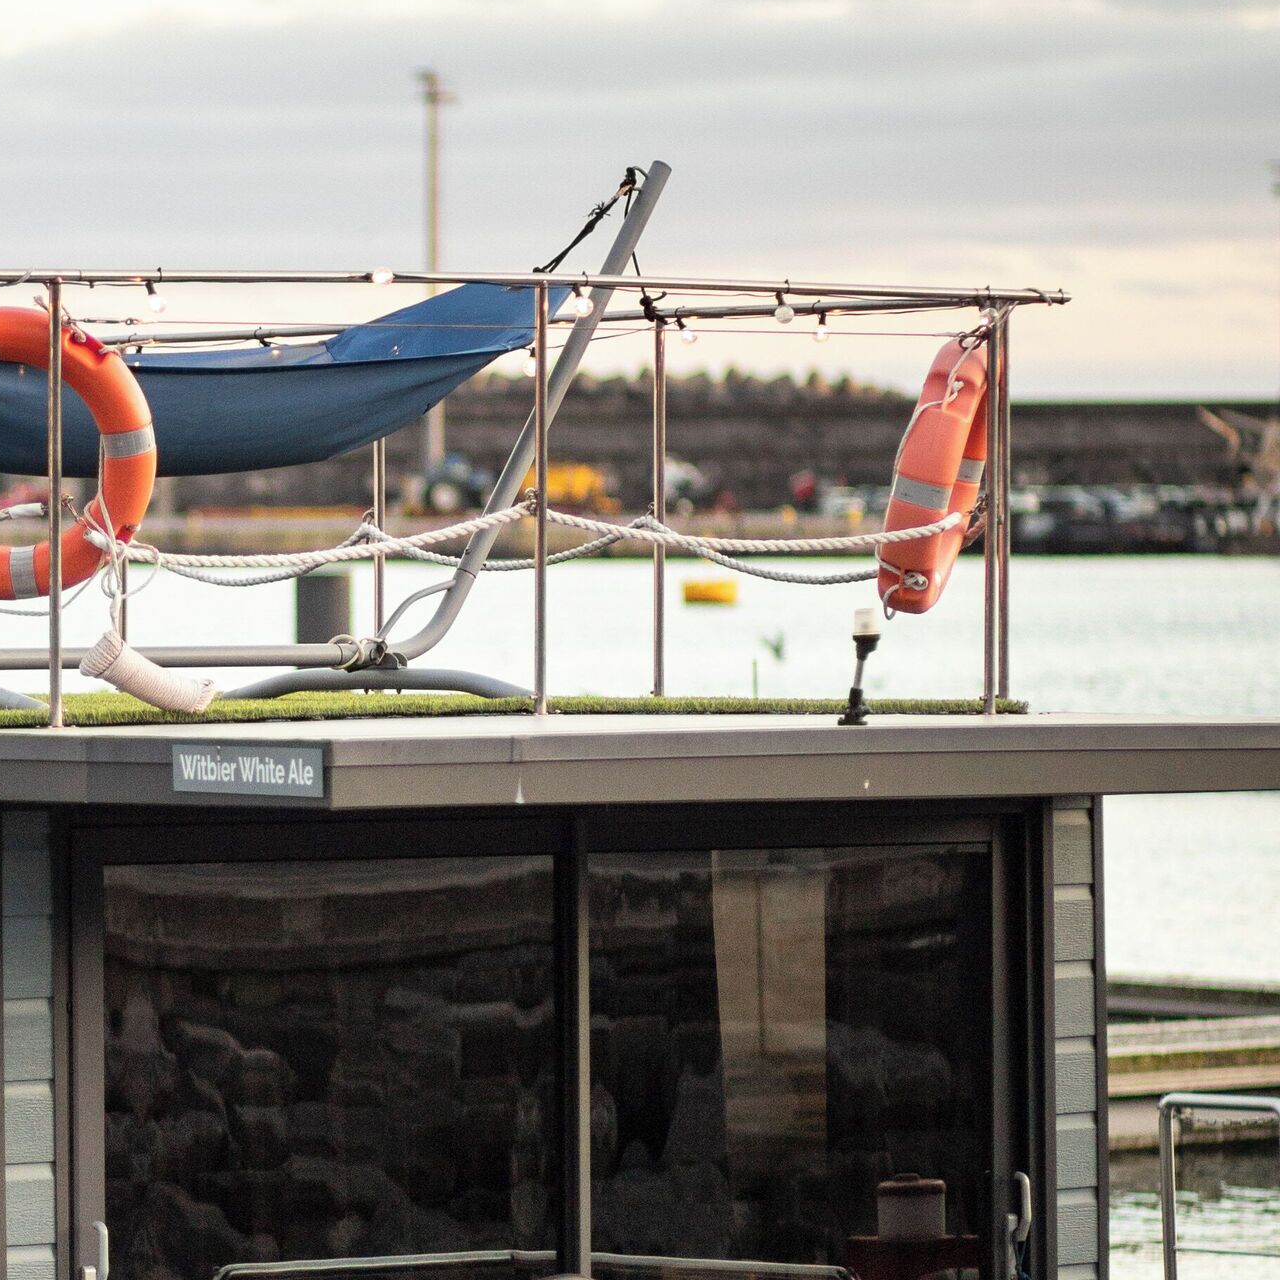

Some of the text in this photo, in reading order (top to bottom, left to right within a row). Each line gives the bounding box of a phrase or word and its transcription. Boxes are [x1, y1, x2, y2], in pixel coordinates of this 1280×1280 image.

[179, 753, 314, 786] Witbier White Ale
